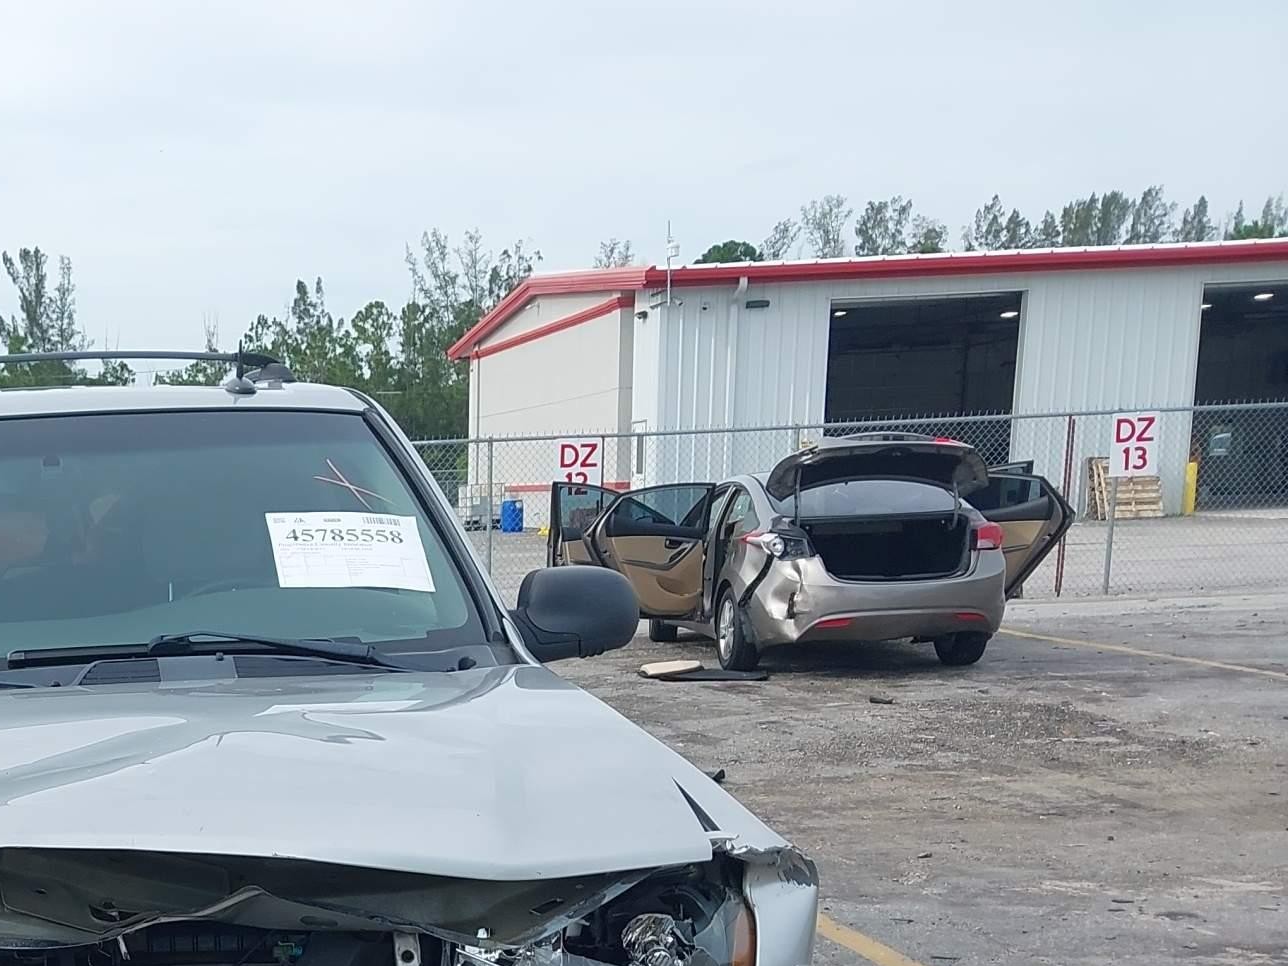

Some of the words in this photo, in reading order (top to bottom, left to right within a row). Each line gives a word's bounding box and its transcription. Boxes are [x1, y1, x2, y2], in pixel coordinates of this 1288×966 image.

[1115, 416, 1155, 443] DZ
[559, 442, 598, 468] DZ
[1122, 446, 1148, 471] 13
[285, 528, 404, 545] 45785558
